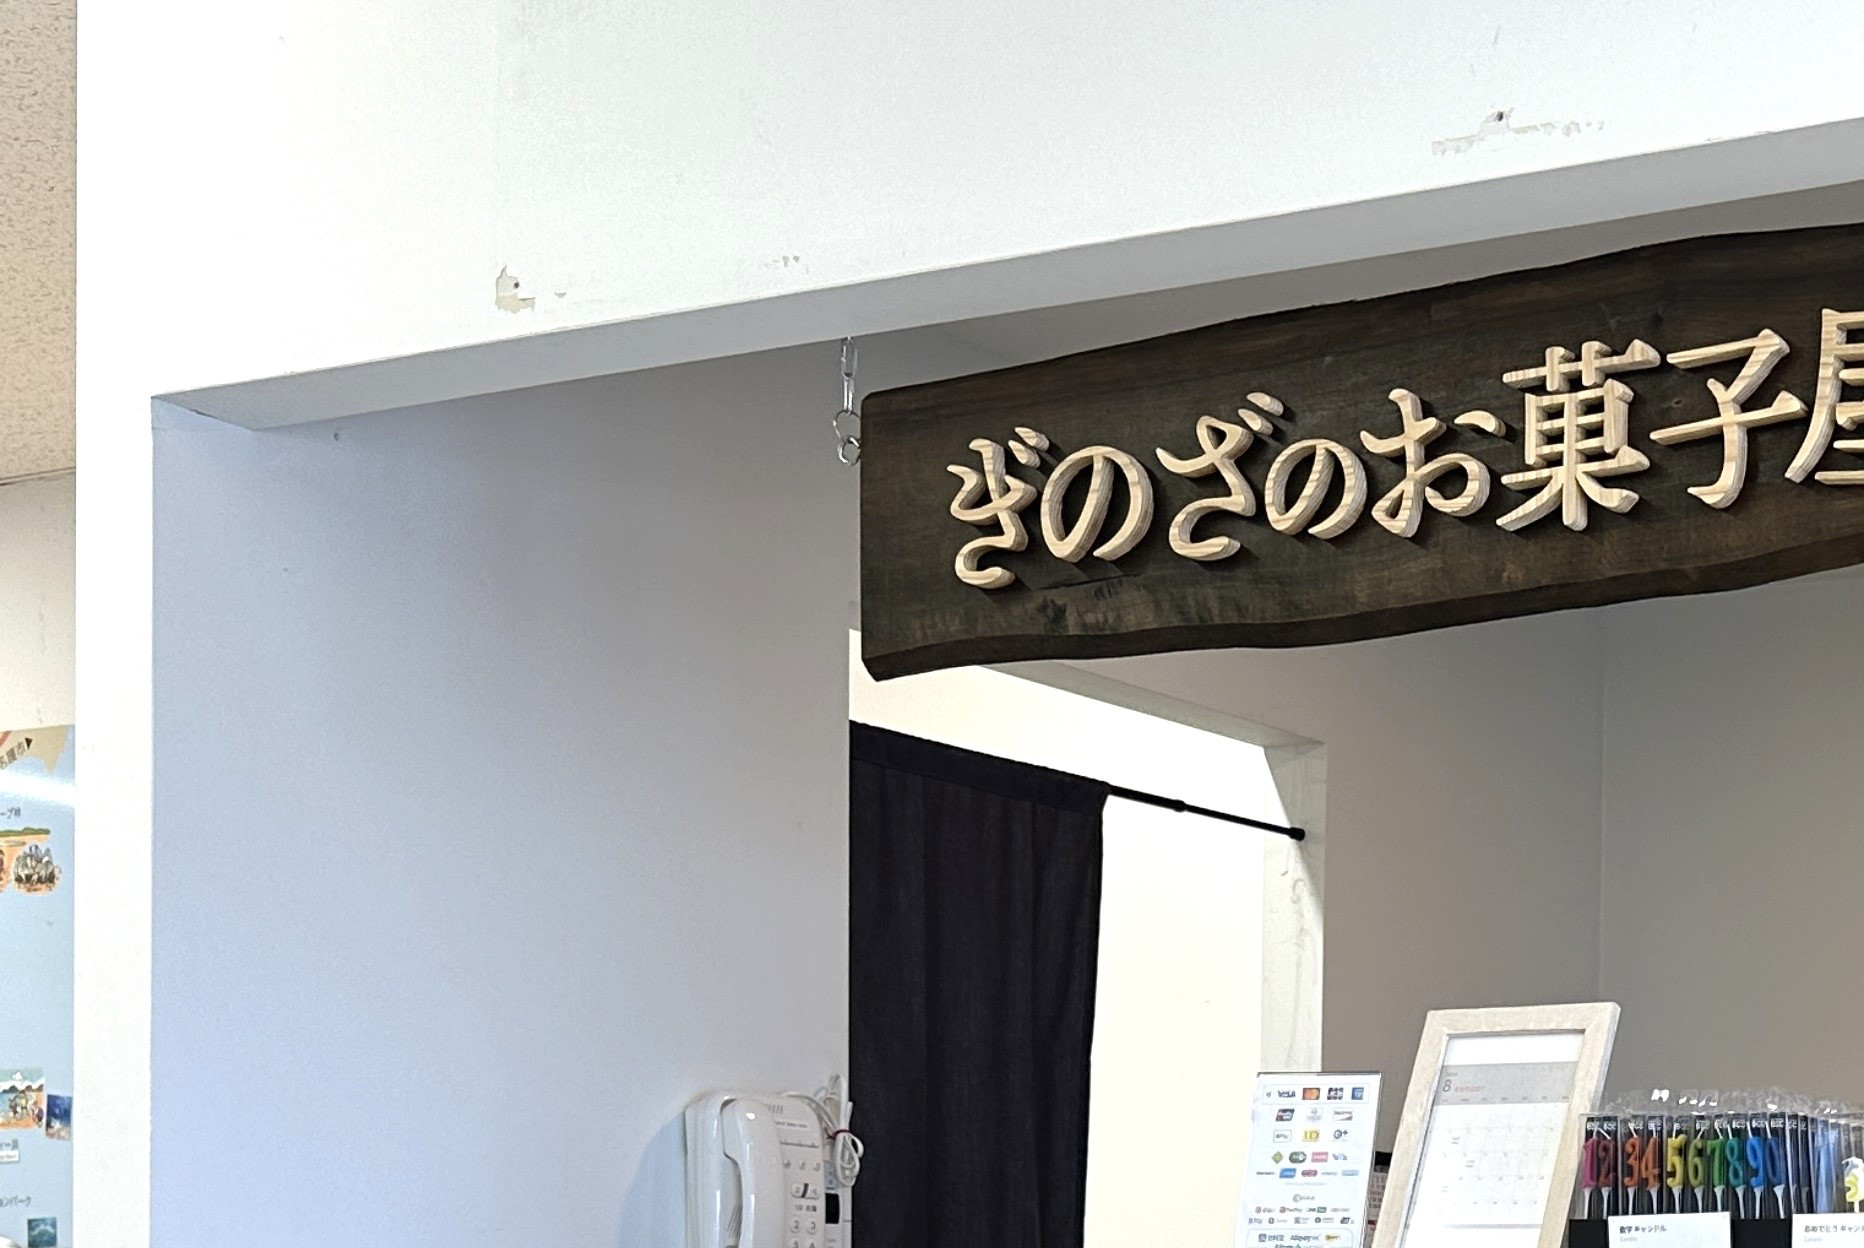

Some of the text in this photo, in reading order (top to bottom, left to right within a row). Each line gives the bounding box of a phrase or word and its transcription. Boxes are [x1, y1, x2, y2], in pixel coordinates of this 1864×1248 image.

[1599, 1138, 1613, 1188] 2
[1624, 1136, 1640, 1187] 3
[1641, 1136, 1660, 1190] 4
[1667, 1134, 1687, 1188] 5
[1688, 1138, 1705, 1187] 6
[1707, 1137, 1726, 1187] 7
[1726, 1137, 1745, 1187] 8
[1746, 1137, 1765, 1187] 9
